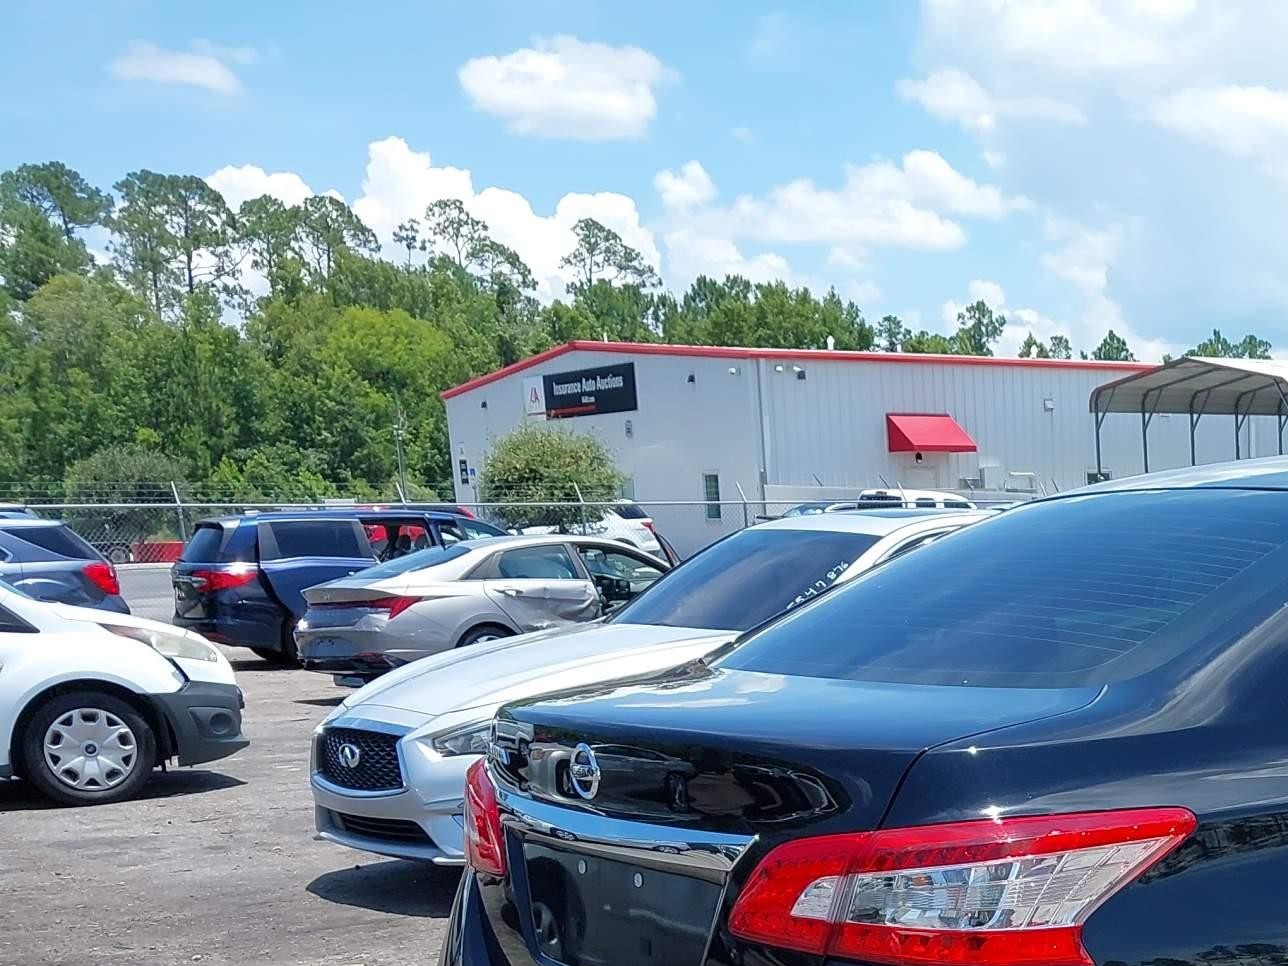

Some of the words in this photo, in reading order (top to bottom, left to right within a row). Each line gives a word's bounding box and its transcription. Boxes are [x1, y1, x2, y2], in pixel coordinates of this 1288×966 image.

[552, 380, 581, 396] Insurance
[582, 377, 596, 393] Auto
[596, 373, 624, 391] Auctions
